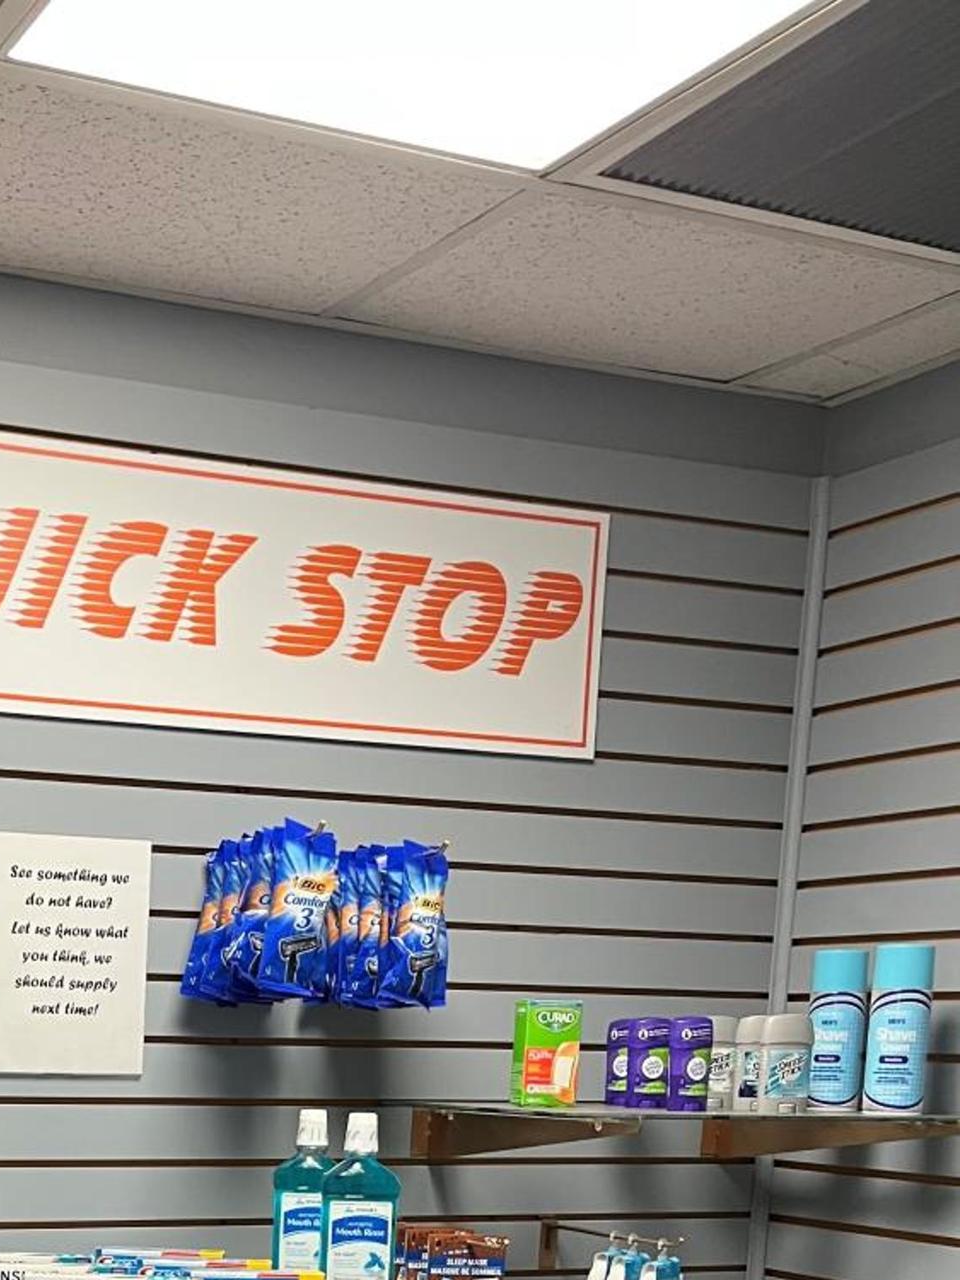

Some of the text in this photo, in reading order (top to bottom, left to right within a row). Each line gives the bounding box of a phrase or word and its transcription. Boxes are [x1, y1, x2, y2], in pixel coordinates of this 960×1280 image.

[259, 543, 585, 678] STOP
[10, 865, 130, 885] See something we
[25, 892, 114, 910] do not have?
[295, 907, 315, 931] 3
[11, 921, 129, 939] Let us know what
[421, 924, 436, 946] 3
[22, 949, 112, 966] you think, we
[15, 976, 118, 992] should supply
[31, 1003, 99, 1016] next time!
[537, 1010, 576, 1024] CURAD
[878, 1027, 917, 1042] Shave
[287, 1218, 312, 1227] Mouth
[336, 1228, 385, 1238] Mouth Rinse
[446, 1258, 489, 1266] SLEEP MASK
[430, 1267, 460, 1275] MASQUE
